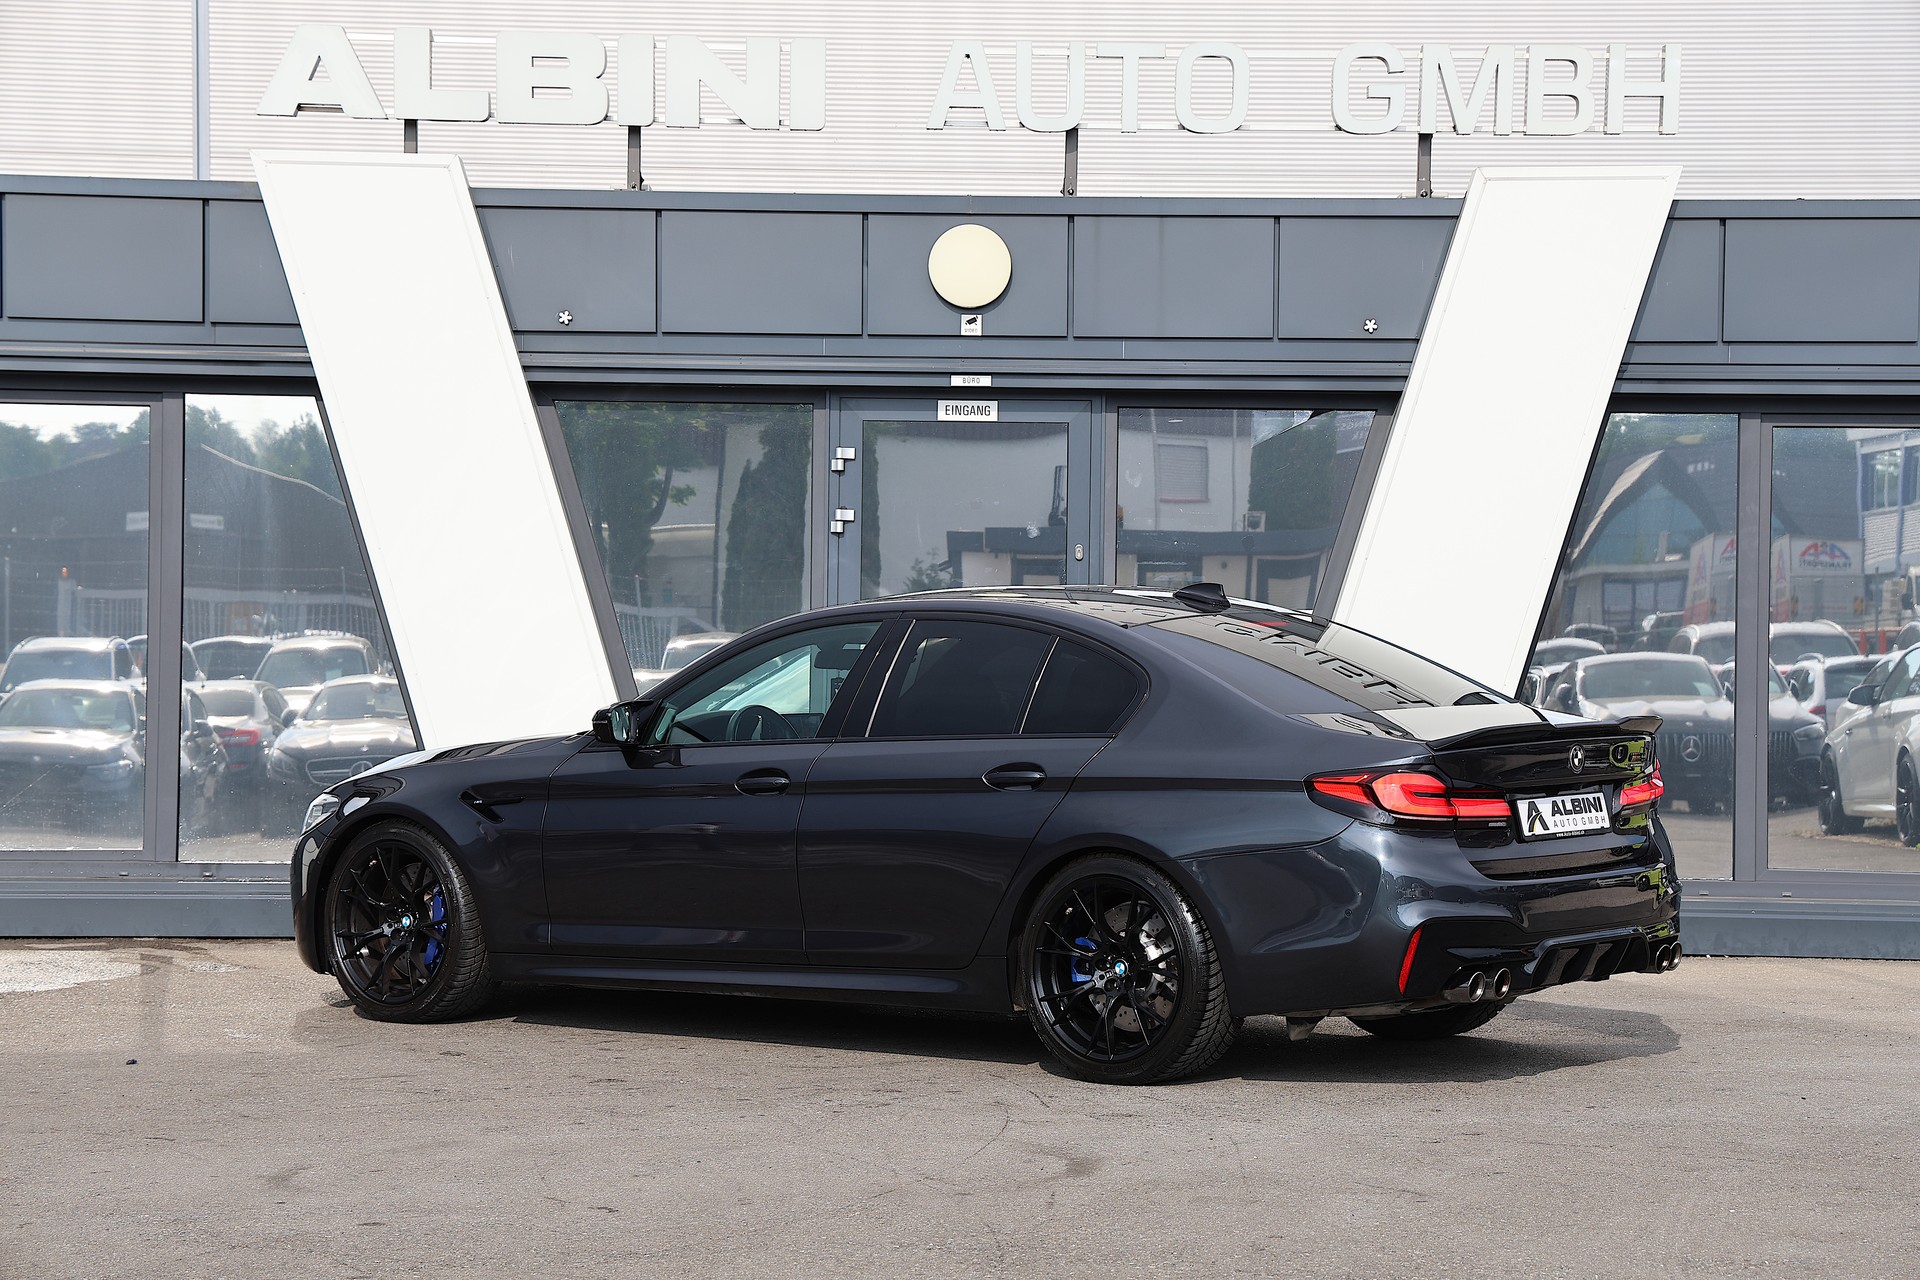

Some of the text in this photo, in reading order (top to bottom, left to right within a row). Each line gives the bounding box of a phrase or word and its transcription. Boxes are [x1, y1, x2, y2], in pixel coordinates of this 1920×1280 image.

[256, 24, 1682, 136] ALBINI AUTO GMBH
[962, 376, 981, 384] BÜRO
[945, 404, 991, 416] EINGANG
[1551, 796, 1604, 817] ALBINI
[1553, 815, 1607, 828] AUTO GMBH
